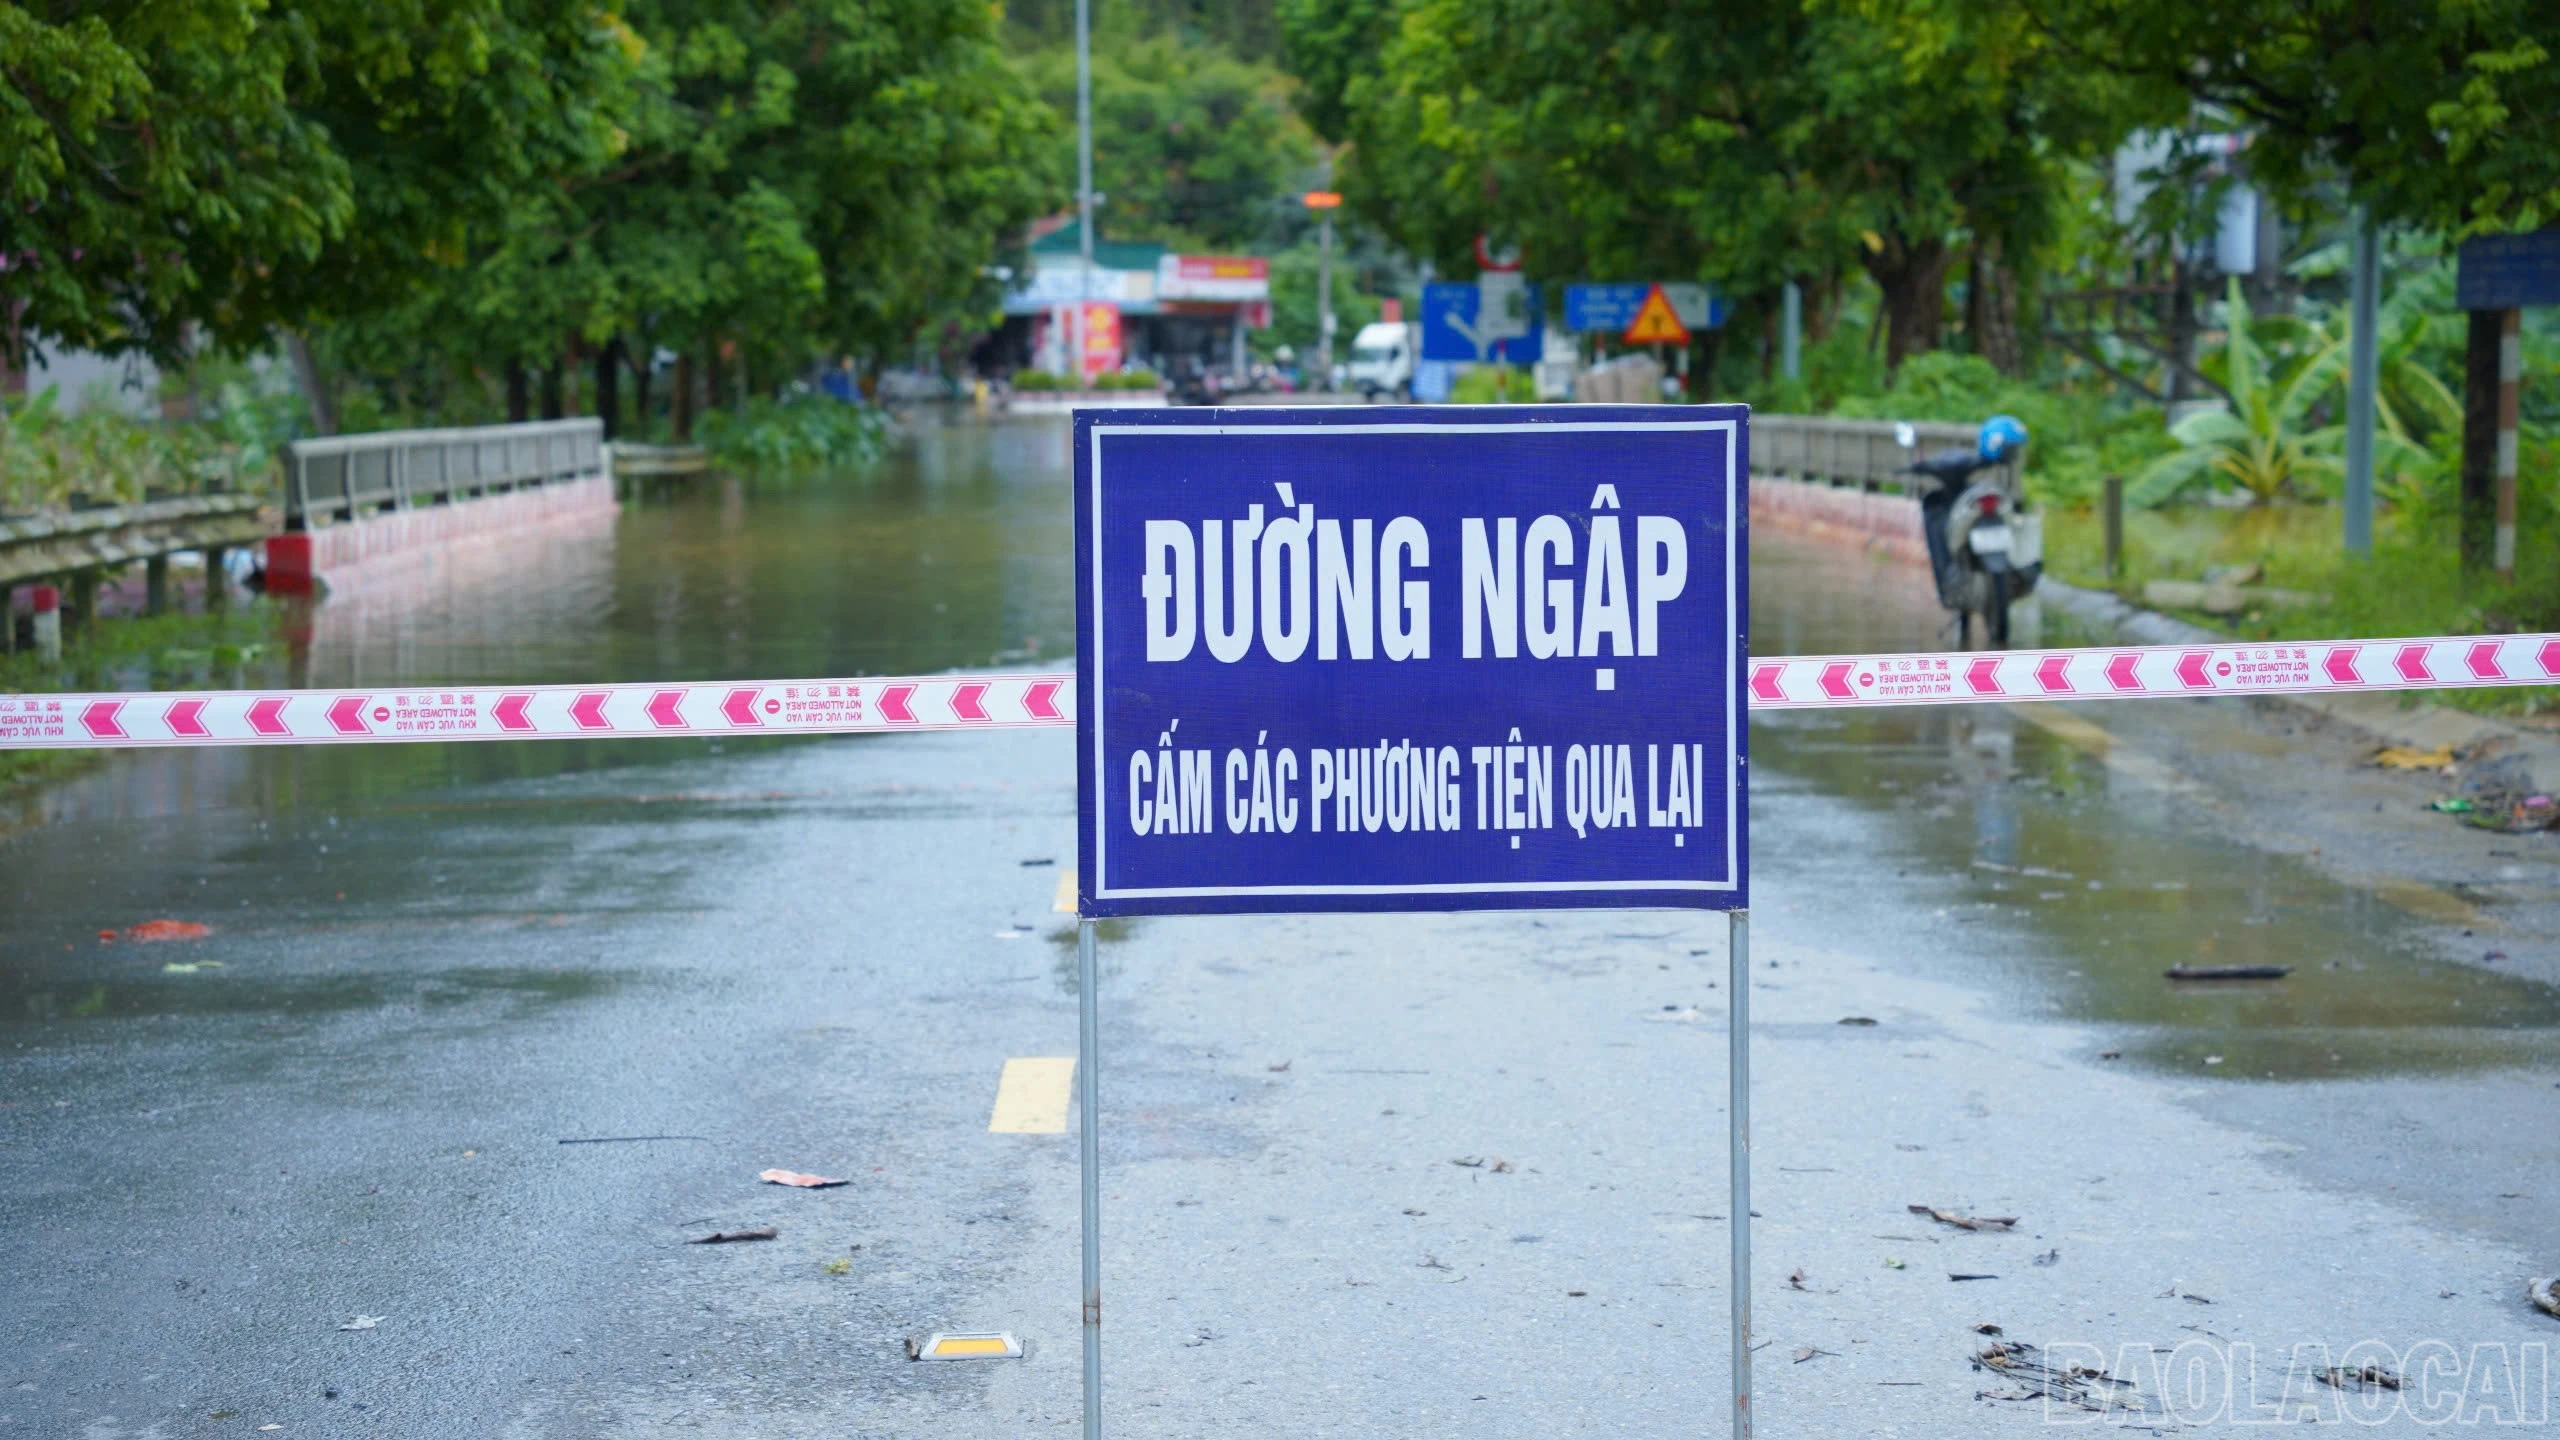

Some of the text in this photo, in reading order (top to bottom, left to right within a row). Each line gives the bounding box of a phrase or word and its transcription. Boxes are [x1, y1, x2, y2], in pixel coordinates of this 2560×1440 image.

[1142, 482, 1687, 690] ĐƯỜNG NGẬP
[2236, 662, 2308, 672] NOT ALLOWED AREA
[1879, 673, 1950, 683] NOT ALLOWED AREA
[2293, 674, 2309, 682] KHU
[1935, 685, 1950, 693] KHU
[786, 700, 861, 710] NOT ALLOWED AREA
[396, 708, 476, 718] NOT ALLOWED AREA
[845, 712, 861, 720] KHU
[2, 715, 63, 724] NOT ALLOWED
[459, 720, 476, 729] KHU
[45, 727, 63, 736] KHU
[1129, 719, 1702, 849] CẤM CÁC PHƯƠNG TIỆN QUA LẠI
